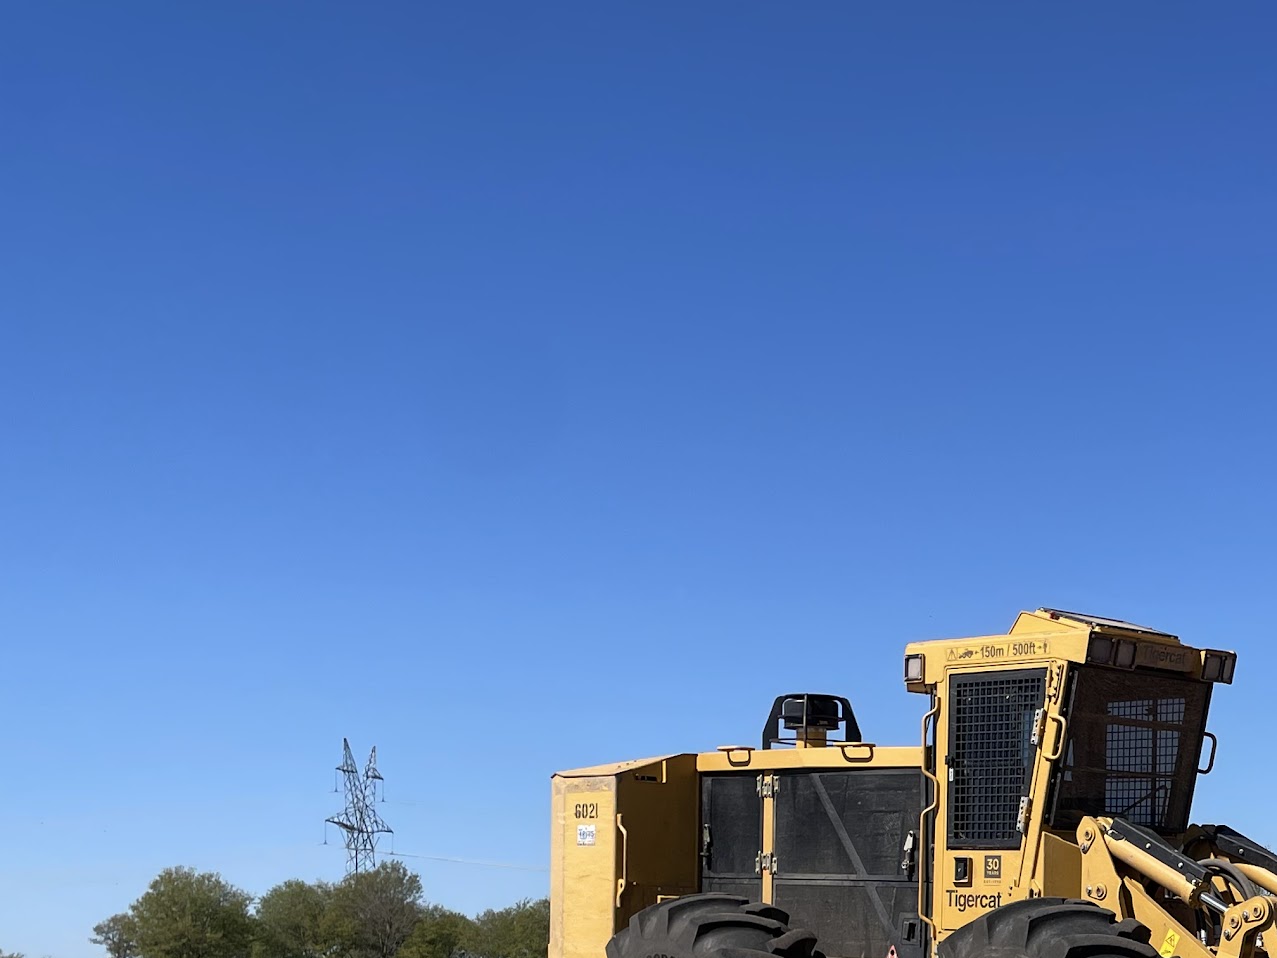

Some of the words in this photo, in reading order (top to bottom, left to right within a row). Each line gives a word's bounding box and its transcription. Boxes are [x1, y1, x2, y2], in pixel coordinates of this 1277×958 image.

[980, 645, 1004, 658] 150m
[1012, 642, 1036, 656] 500ft
[986, 858, 999, 870] 30
[946, 890, 1001, 912] Tigercat
